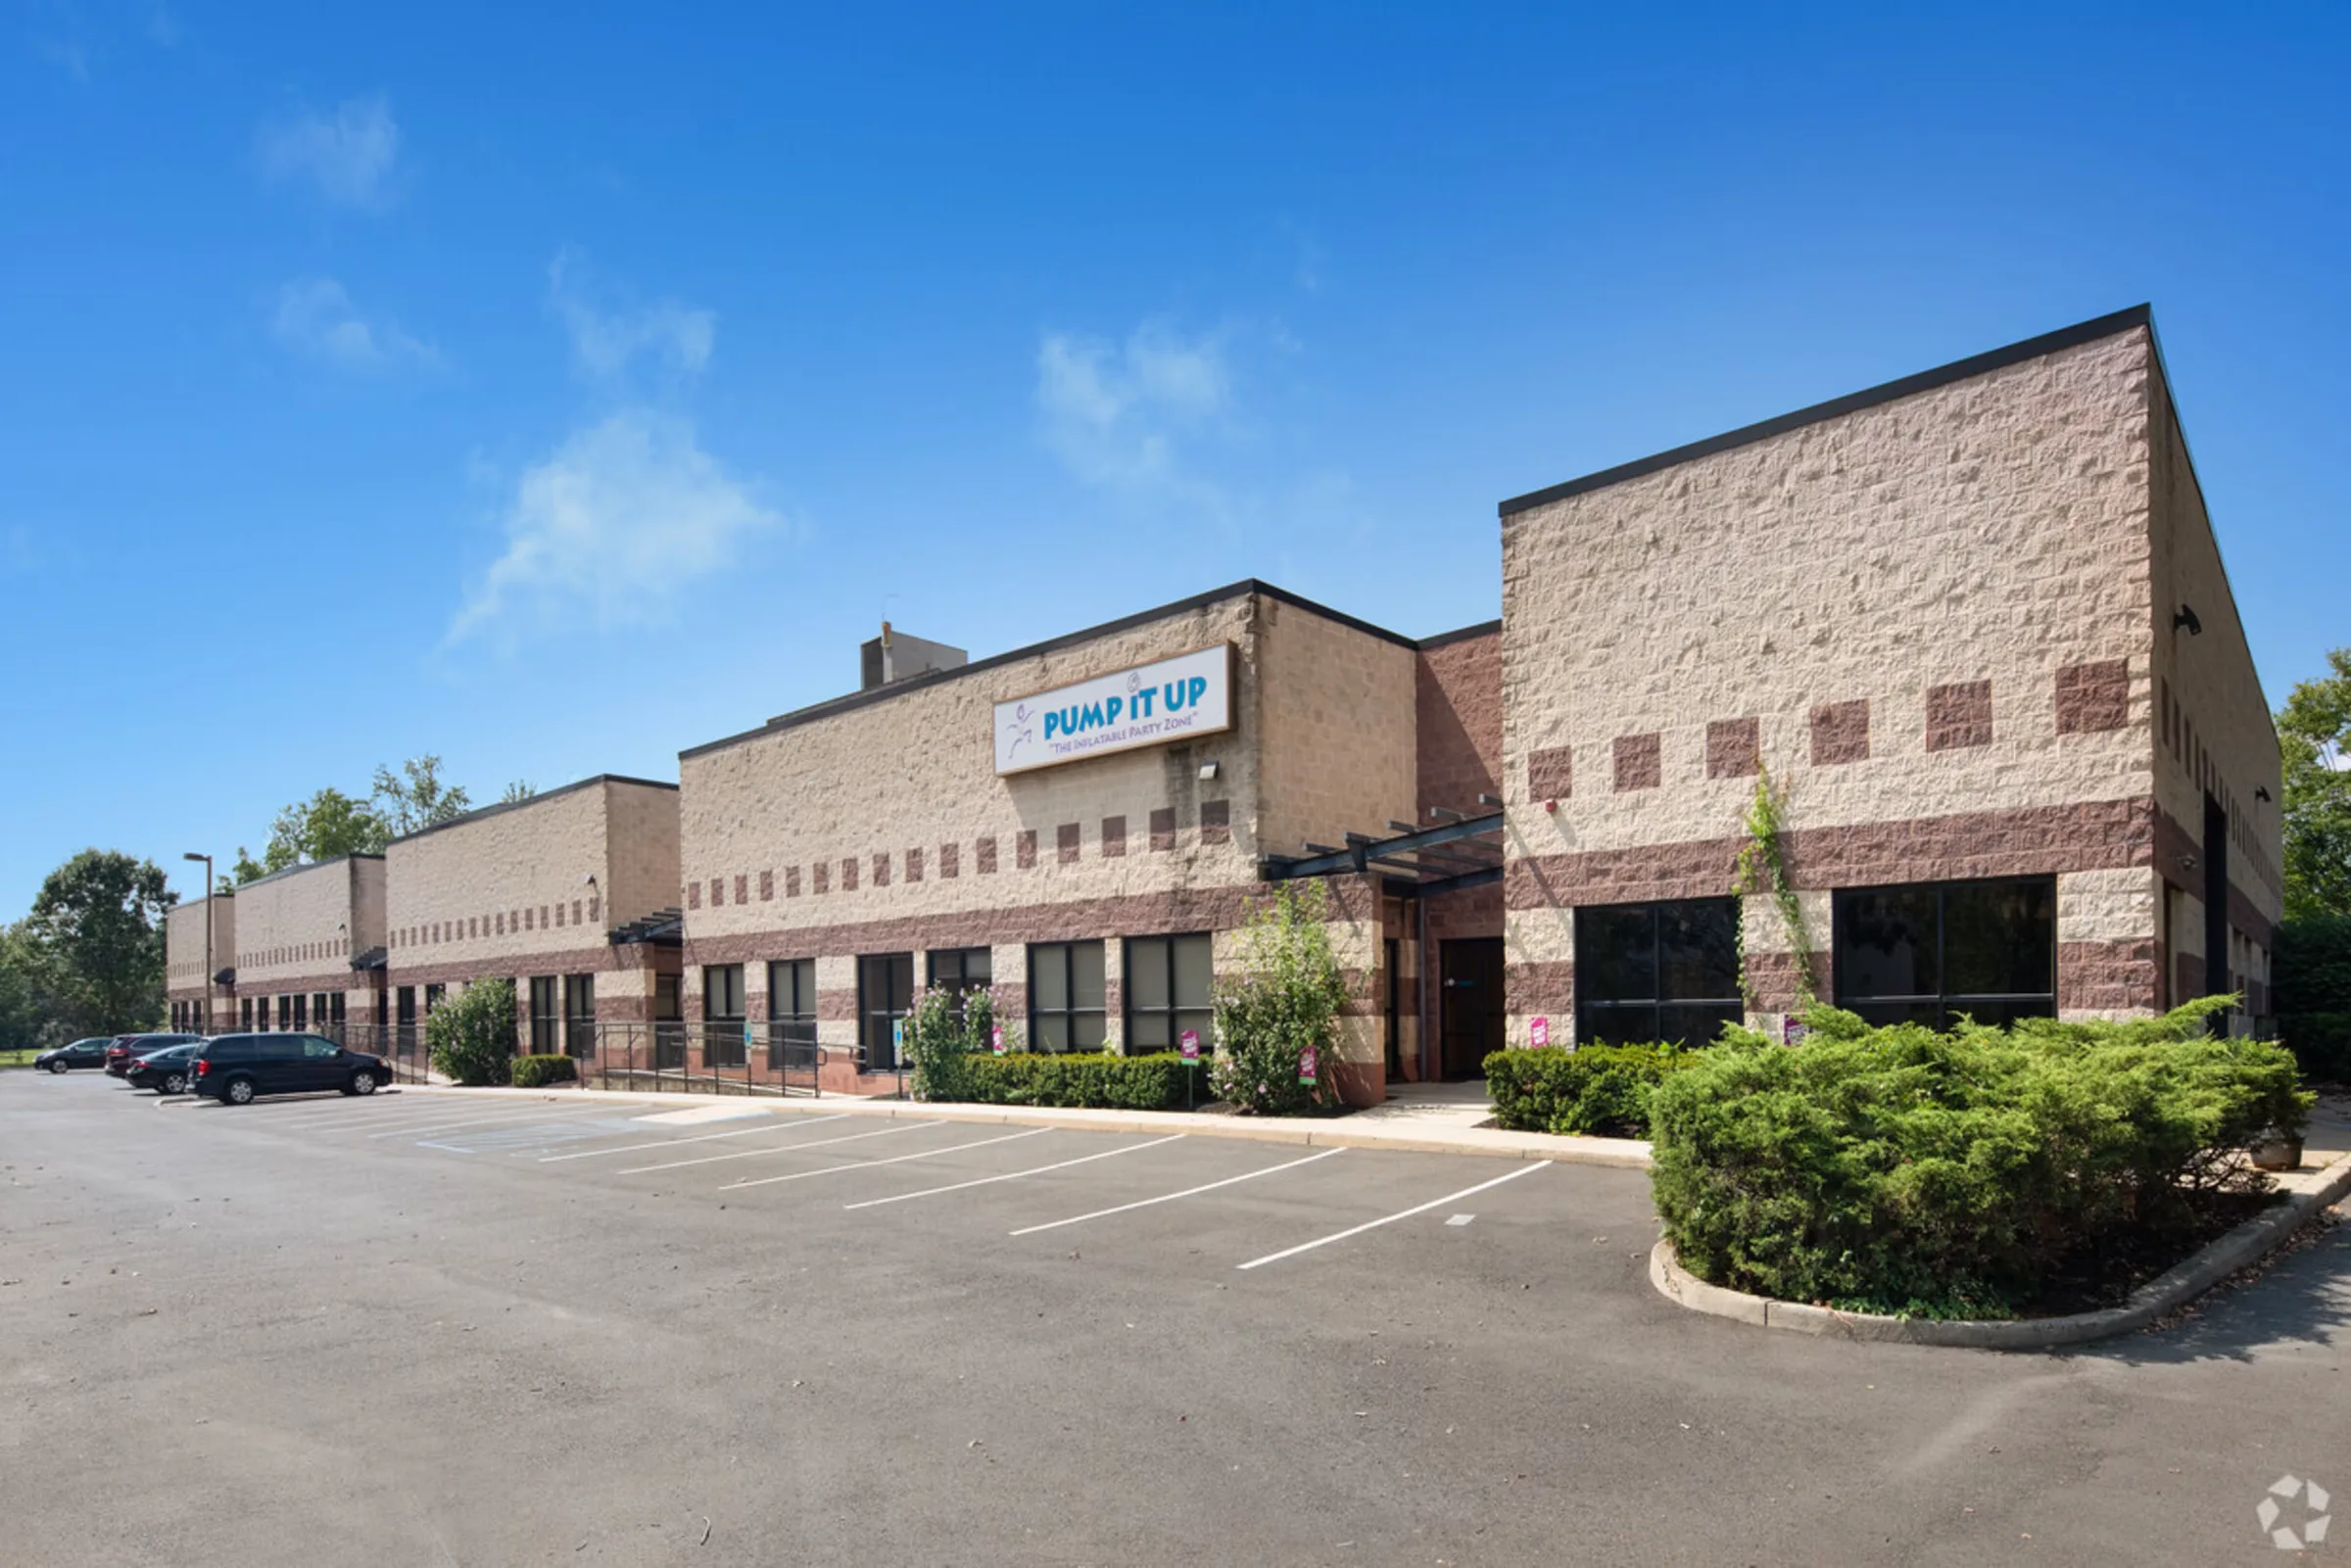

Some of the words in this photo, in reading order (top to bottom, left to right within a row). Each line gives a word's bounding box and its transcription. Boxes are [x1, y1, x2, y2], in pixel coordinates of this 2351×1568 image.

[1043, 695, 1124, 740] PUMP
[1164, 676, 1207, 712] UP
[1074, 728, 1127, 750] INFLATABLE
[1128, 722, 1163, 738] PARTY
